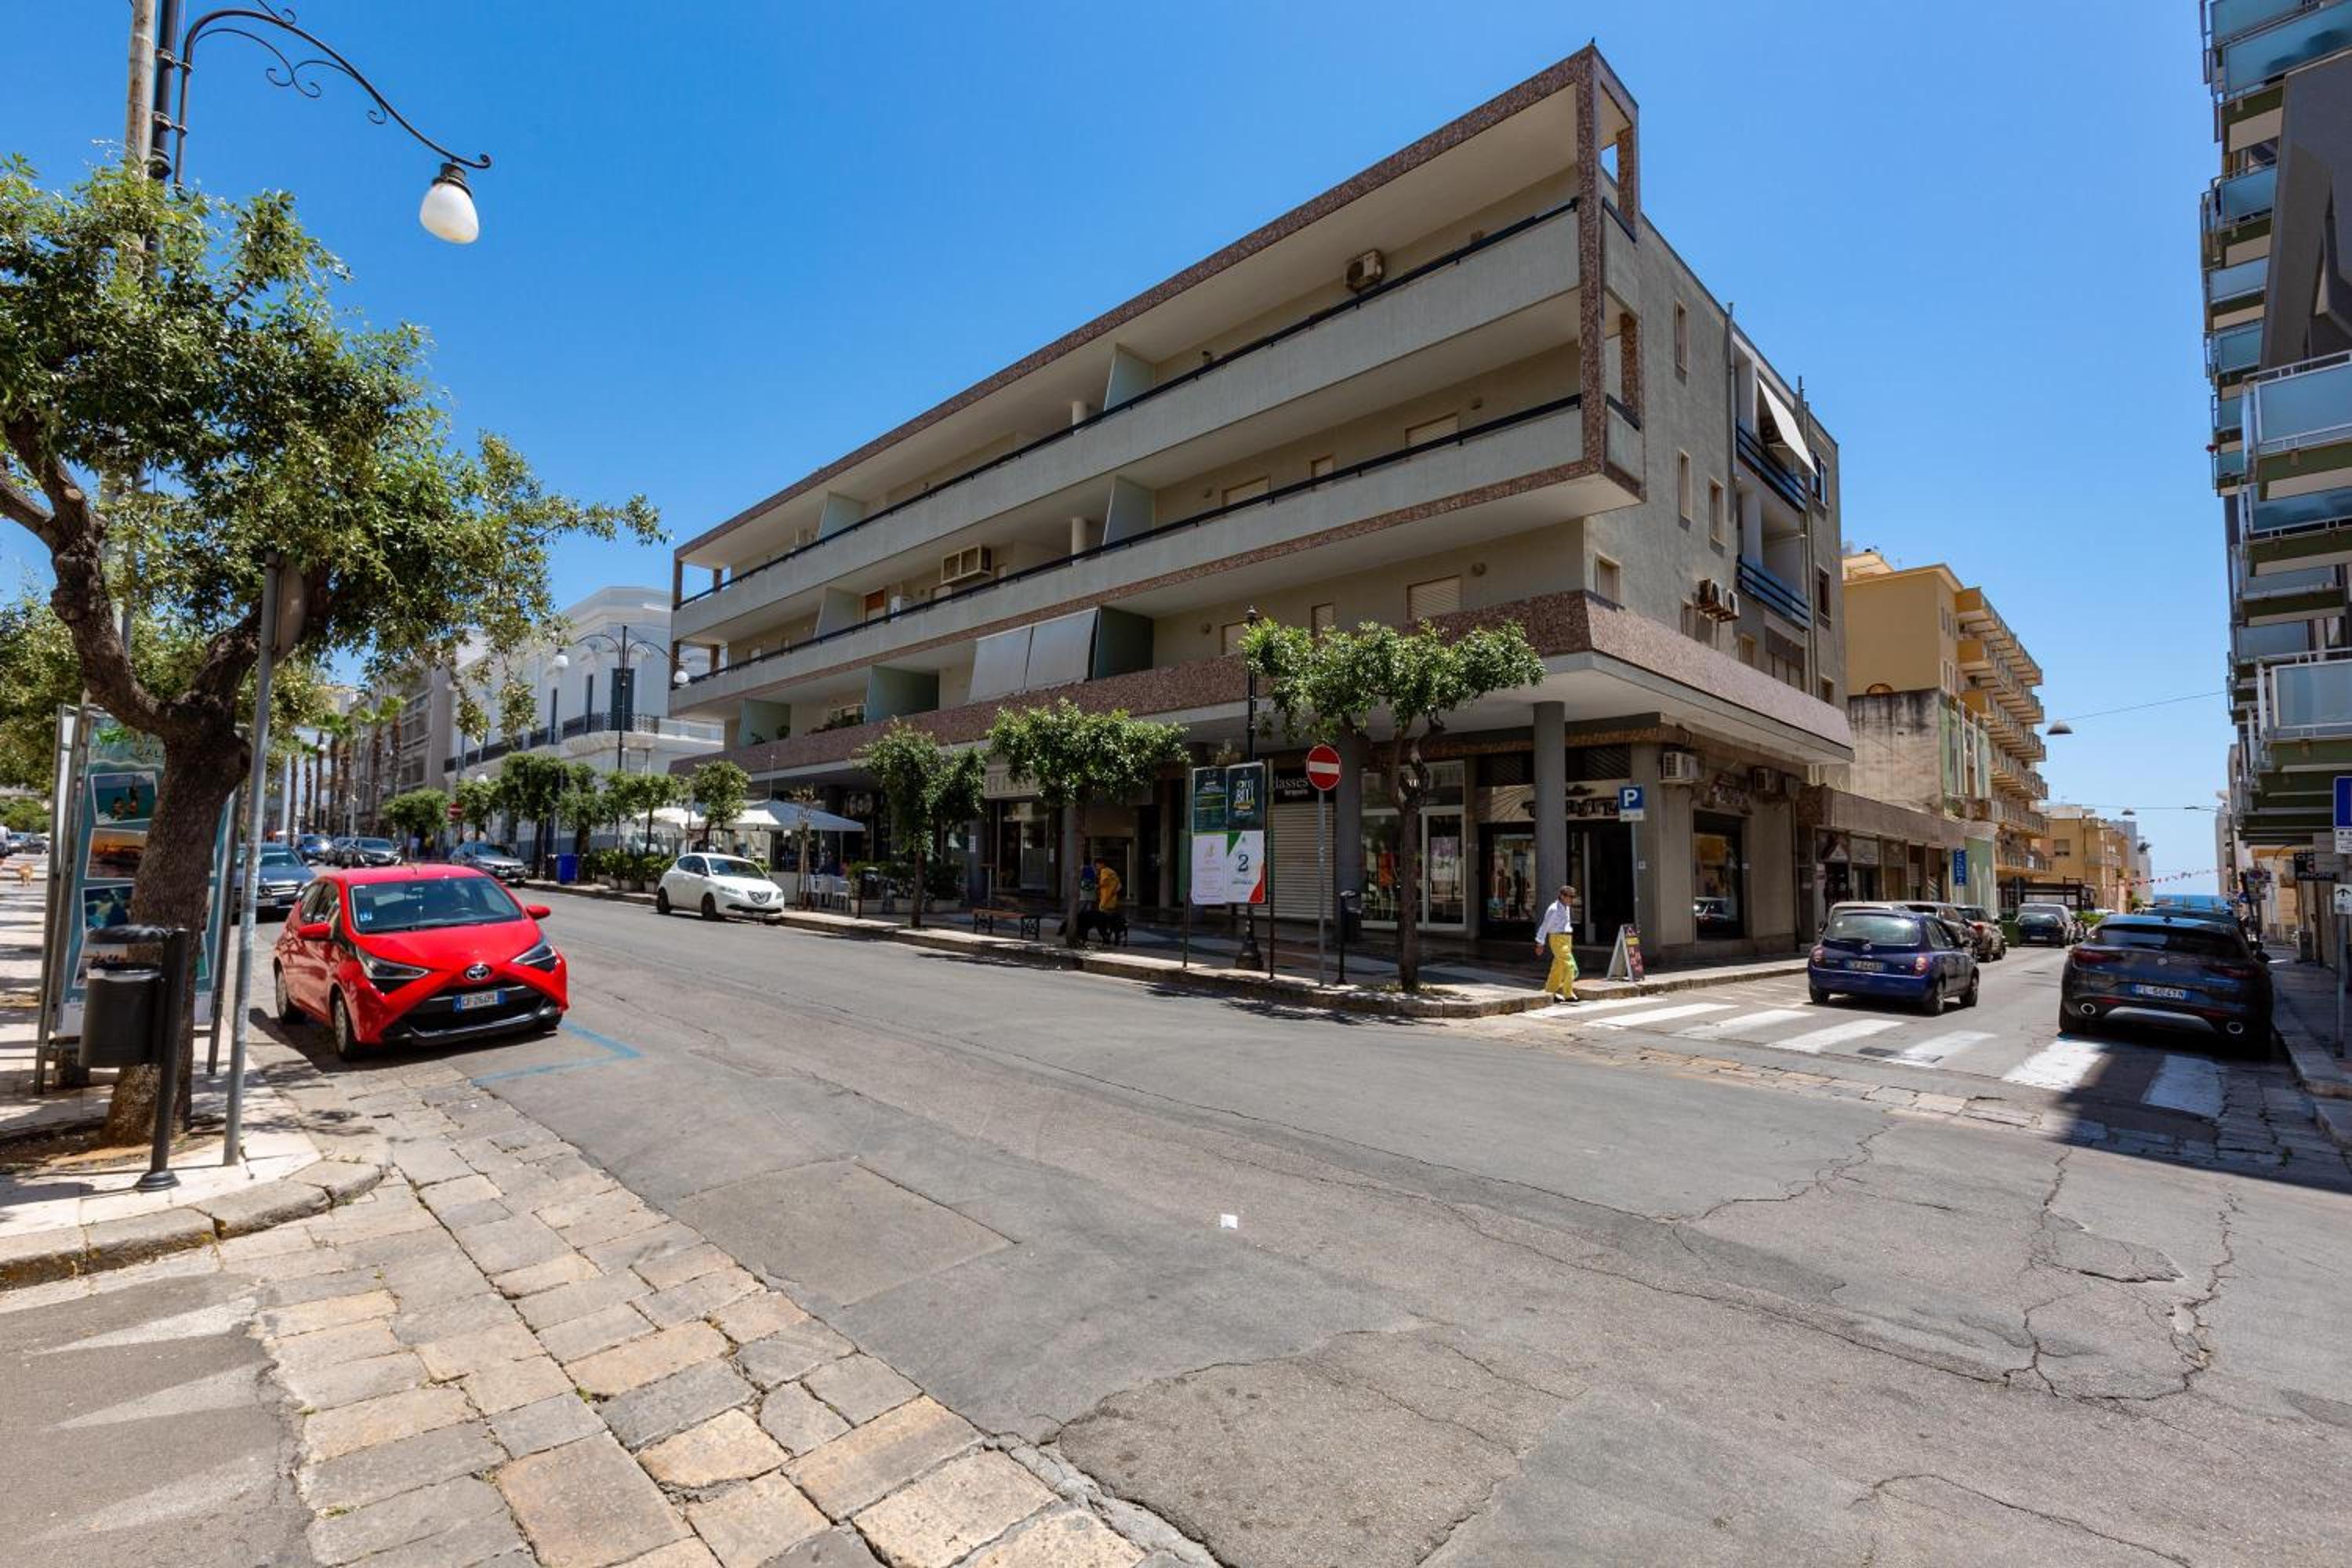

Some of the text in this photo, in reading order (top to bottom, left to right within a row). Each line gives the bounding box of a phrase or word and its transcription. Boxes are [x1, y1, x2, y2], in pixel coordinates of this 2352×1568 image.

[1274, 775, 1308, 790] lasses
[1624, 789, 1637, 807] P
[1238, 854, 1249, 872] 2
